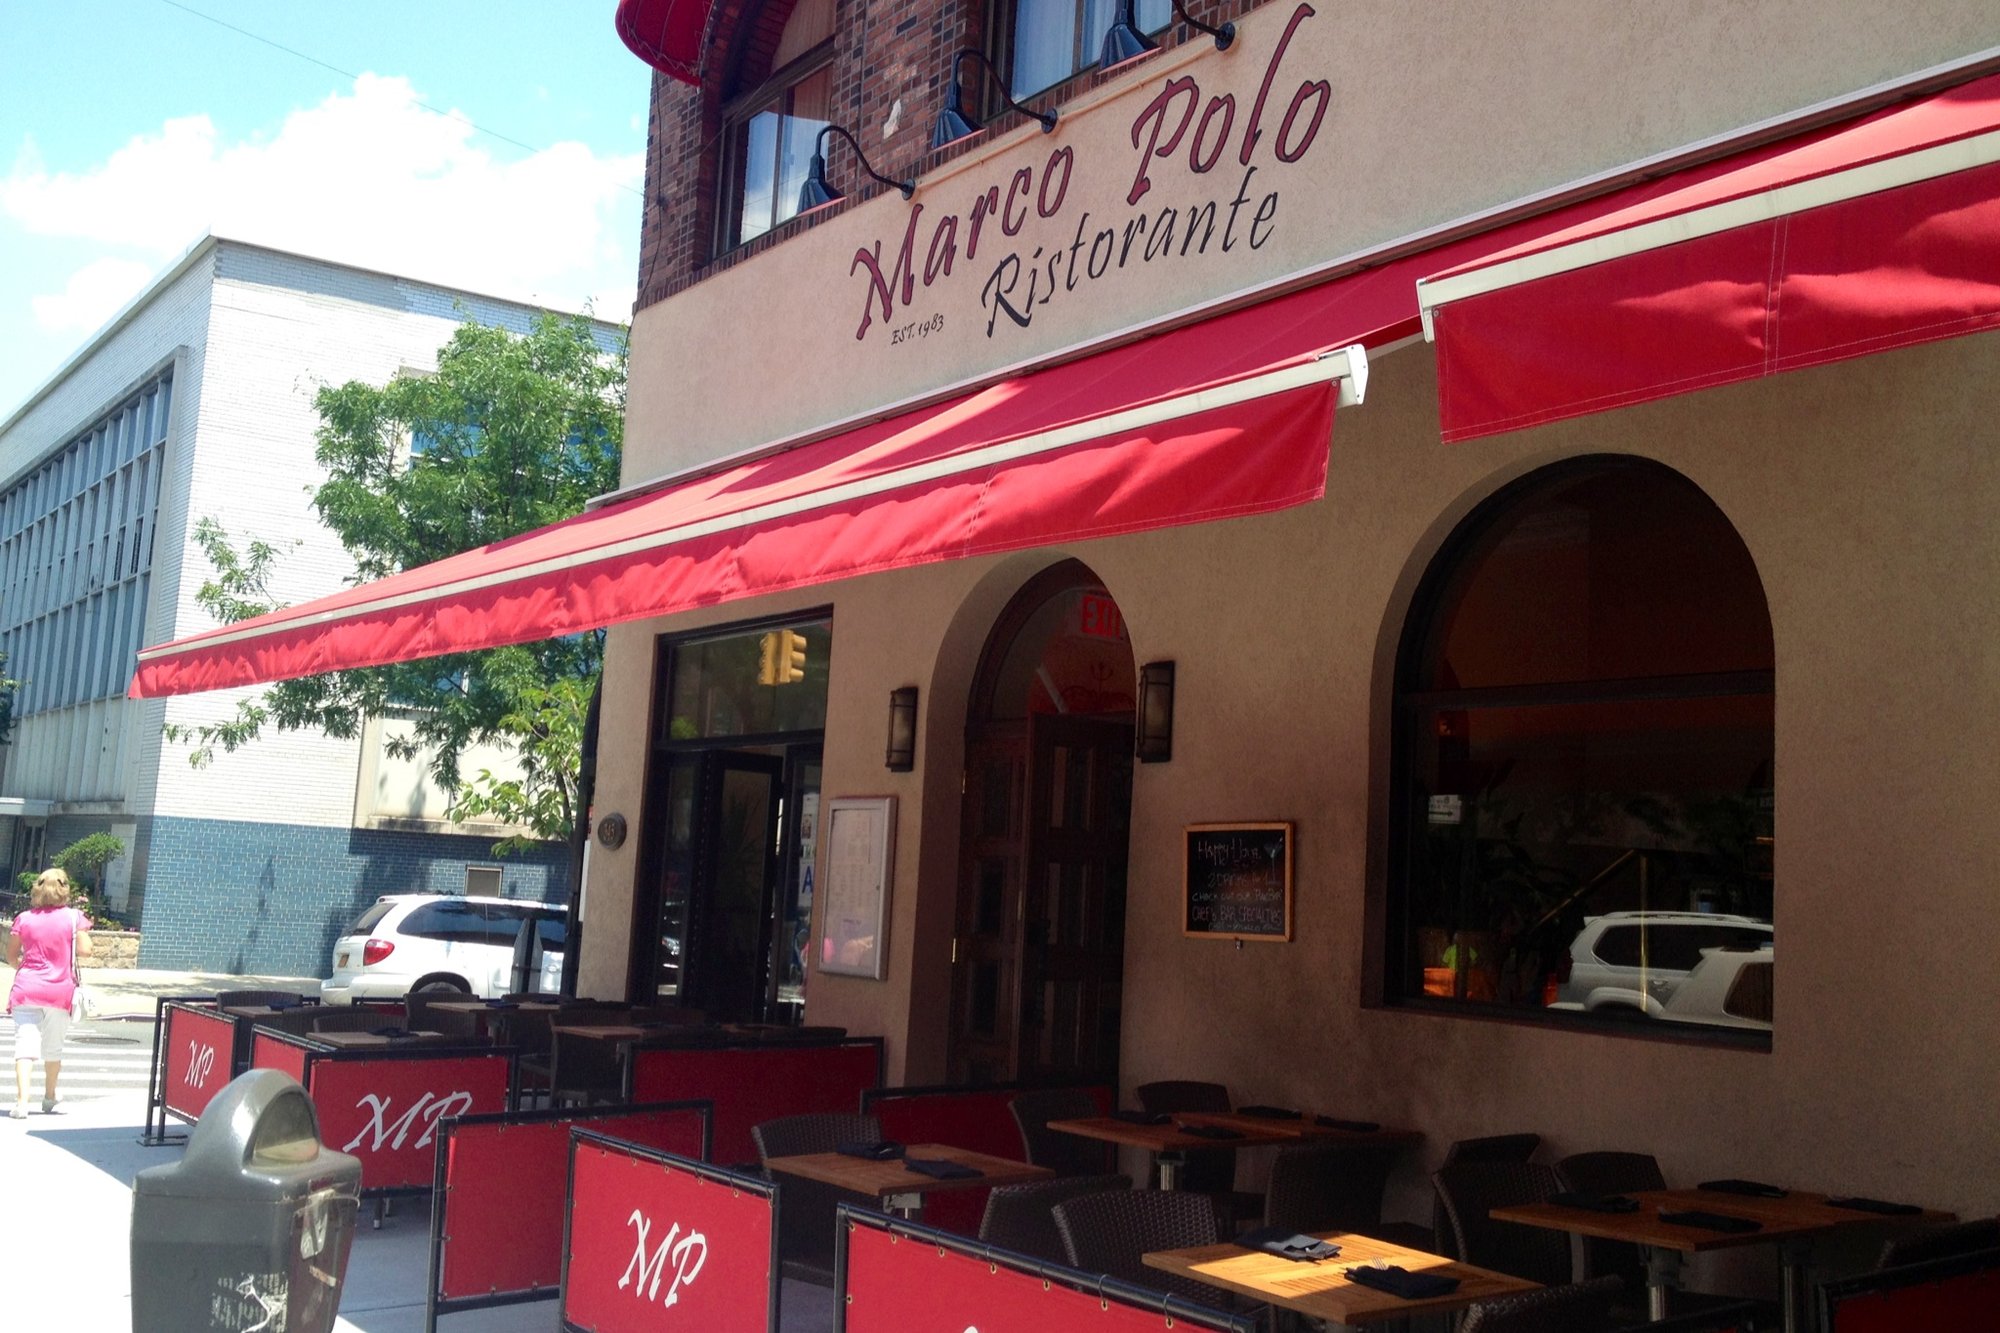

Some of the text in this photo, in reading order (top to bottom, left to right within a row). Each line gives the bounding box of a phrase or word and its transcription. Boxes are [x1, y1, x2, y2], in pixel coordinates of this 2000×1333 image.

[850, 2, 1332, 341] Marco Polo
[981, 166, 1278, 338] Ristorante
[891, 312, 944, 346] EST. 1983
[801, 865, 813, 894] A
[184, 1039, 215, 1089] MP
[342, 1091, 473, 1153] MP
[618, 1208, 708, 1309] MP
